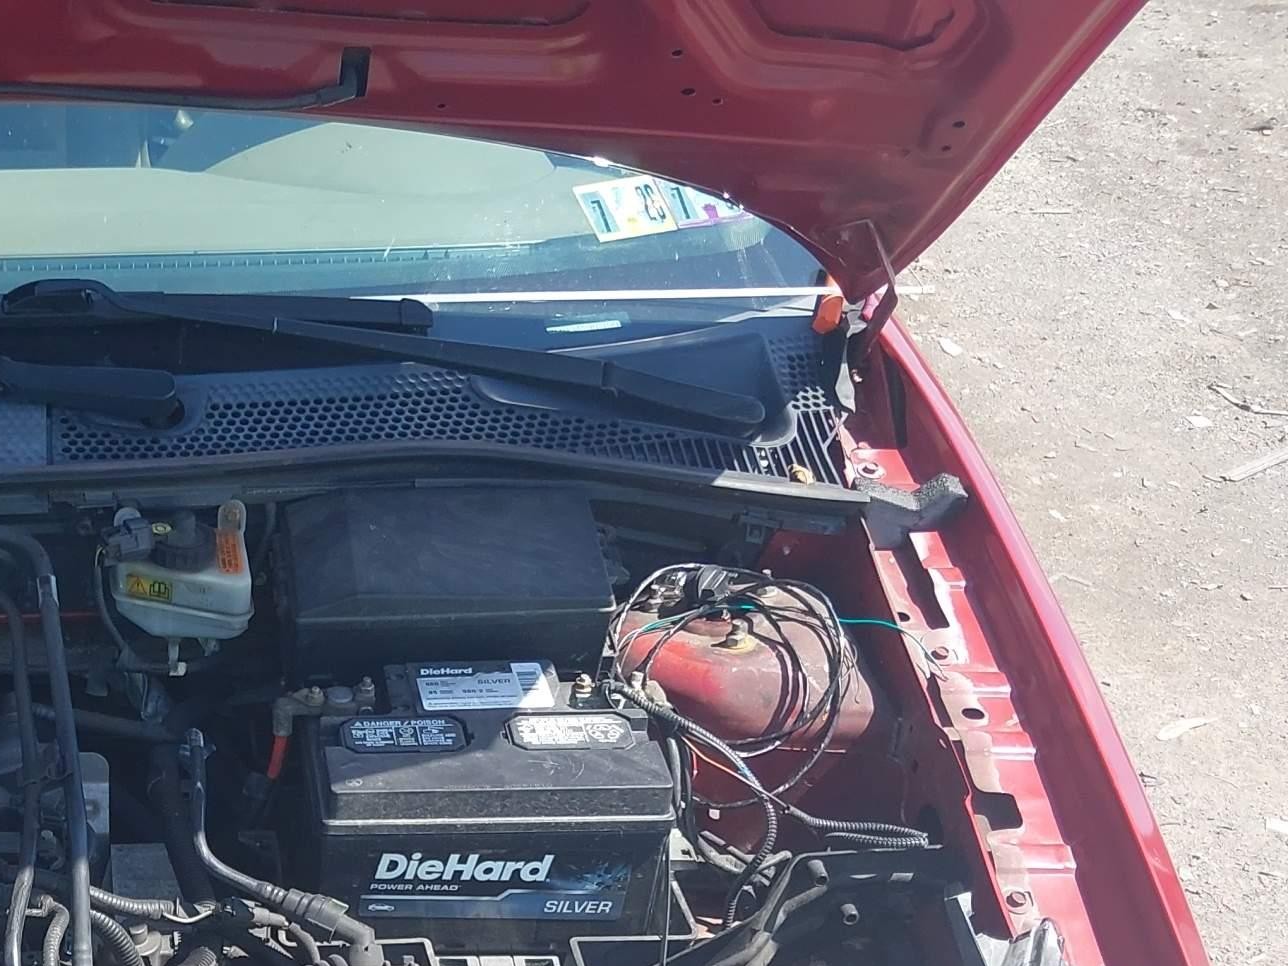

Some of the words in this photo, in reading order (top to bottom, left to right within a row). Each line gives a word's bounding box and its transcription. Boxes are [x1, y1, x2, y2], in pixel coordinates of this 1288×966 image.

[670, 186, 691, 220] 7
[590, 199, 612, 233] 7
[420, 667, 473, 676] DieHard
[363, 720, 402, 728] DANGER
[374, 852, 555, 882] DieHard
[370, 883, 414, 891] POWER
[543, 900, 613, 914] SILVER
